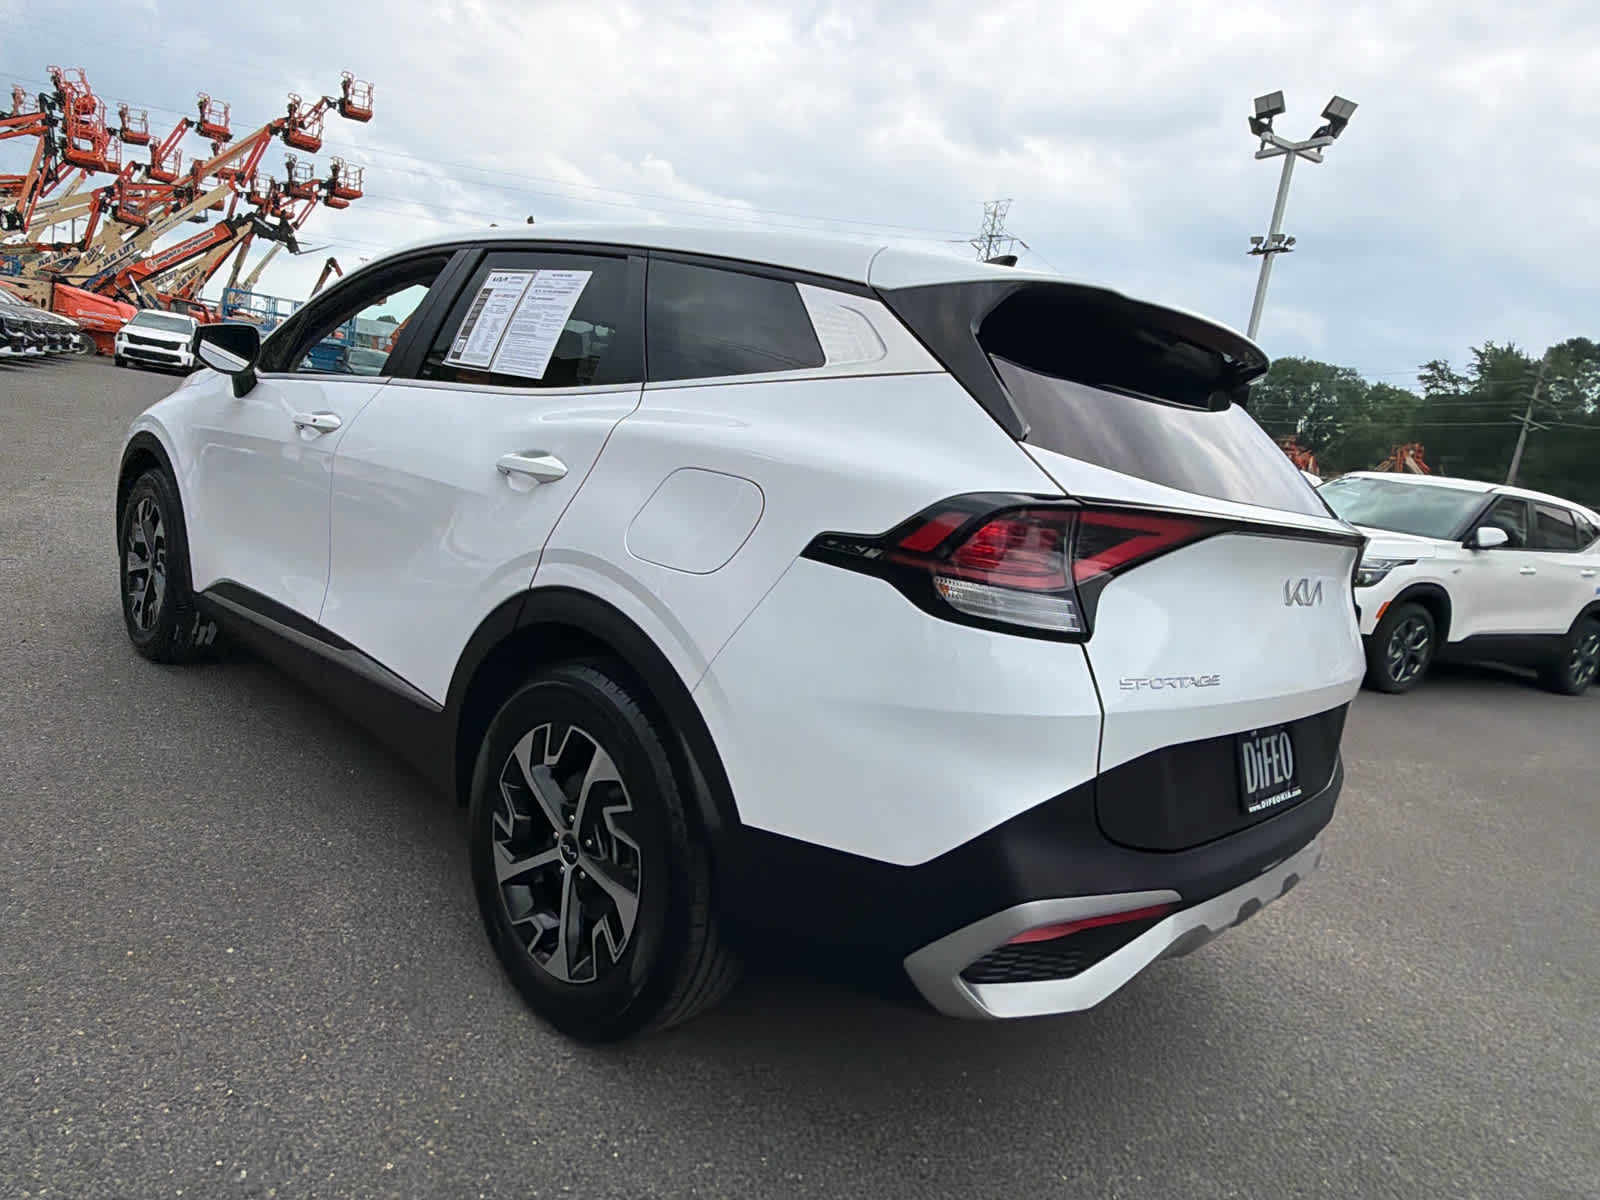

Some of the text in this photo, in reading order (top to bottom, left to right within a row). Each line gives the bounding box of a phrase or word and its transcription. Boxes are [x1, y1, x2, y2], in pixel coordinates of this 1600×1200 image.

[102, 253, 117, 267] JLG
[117, 241, 136, 254] LIFT
[187, 265, 200, 278] LIFT
[1119, 674, 1221, 691] SPORTAGE
